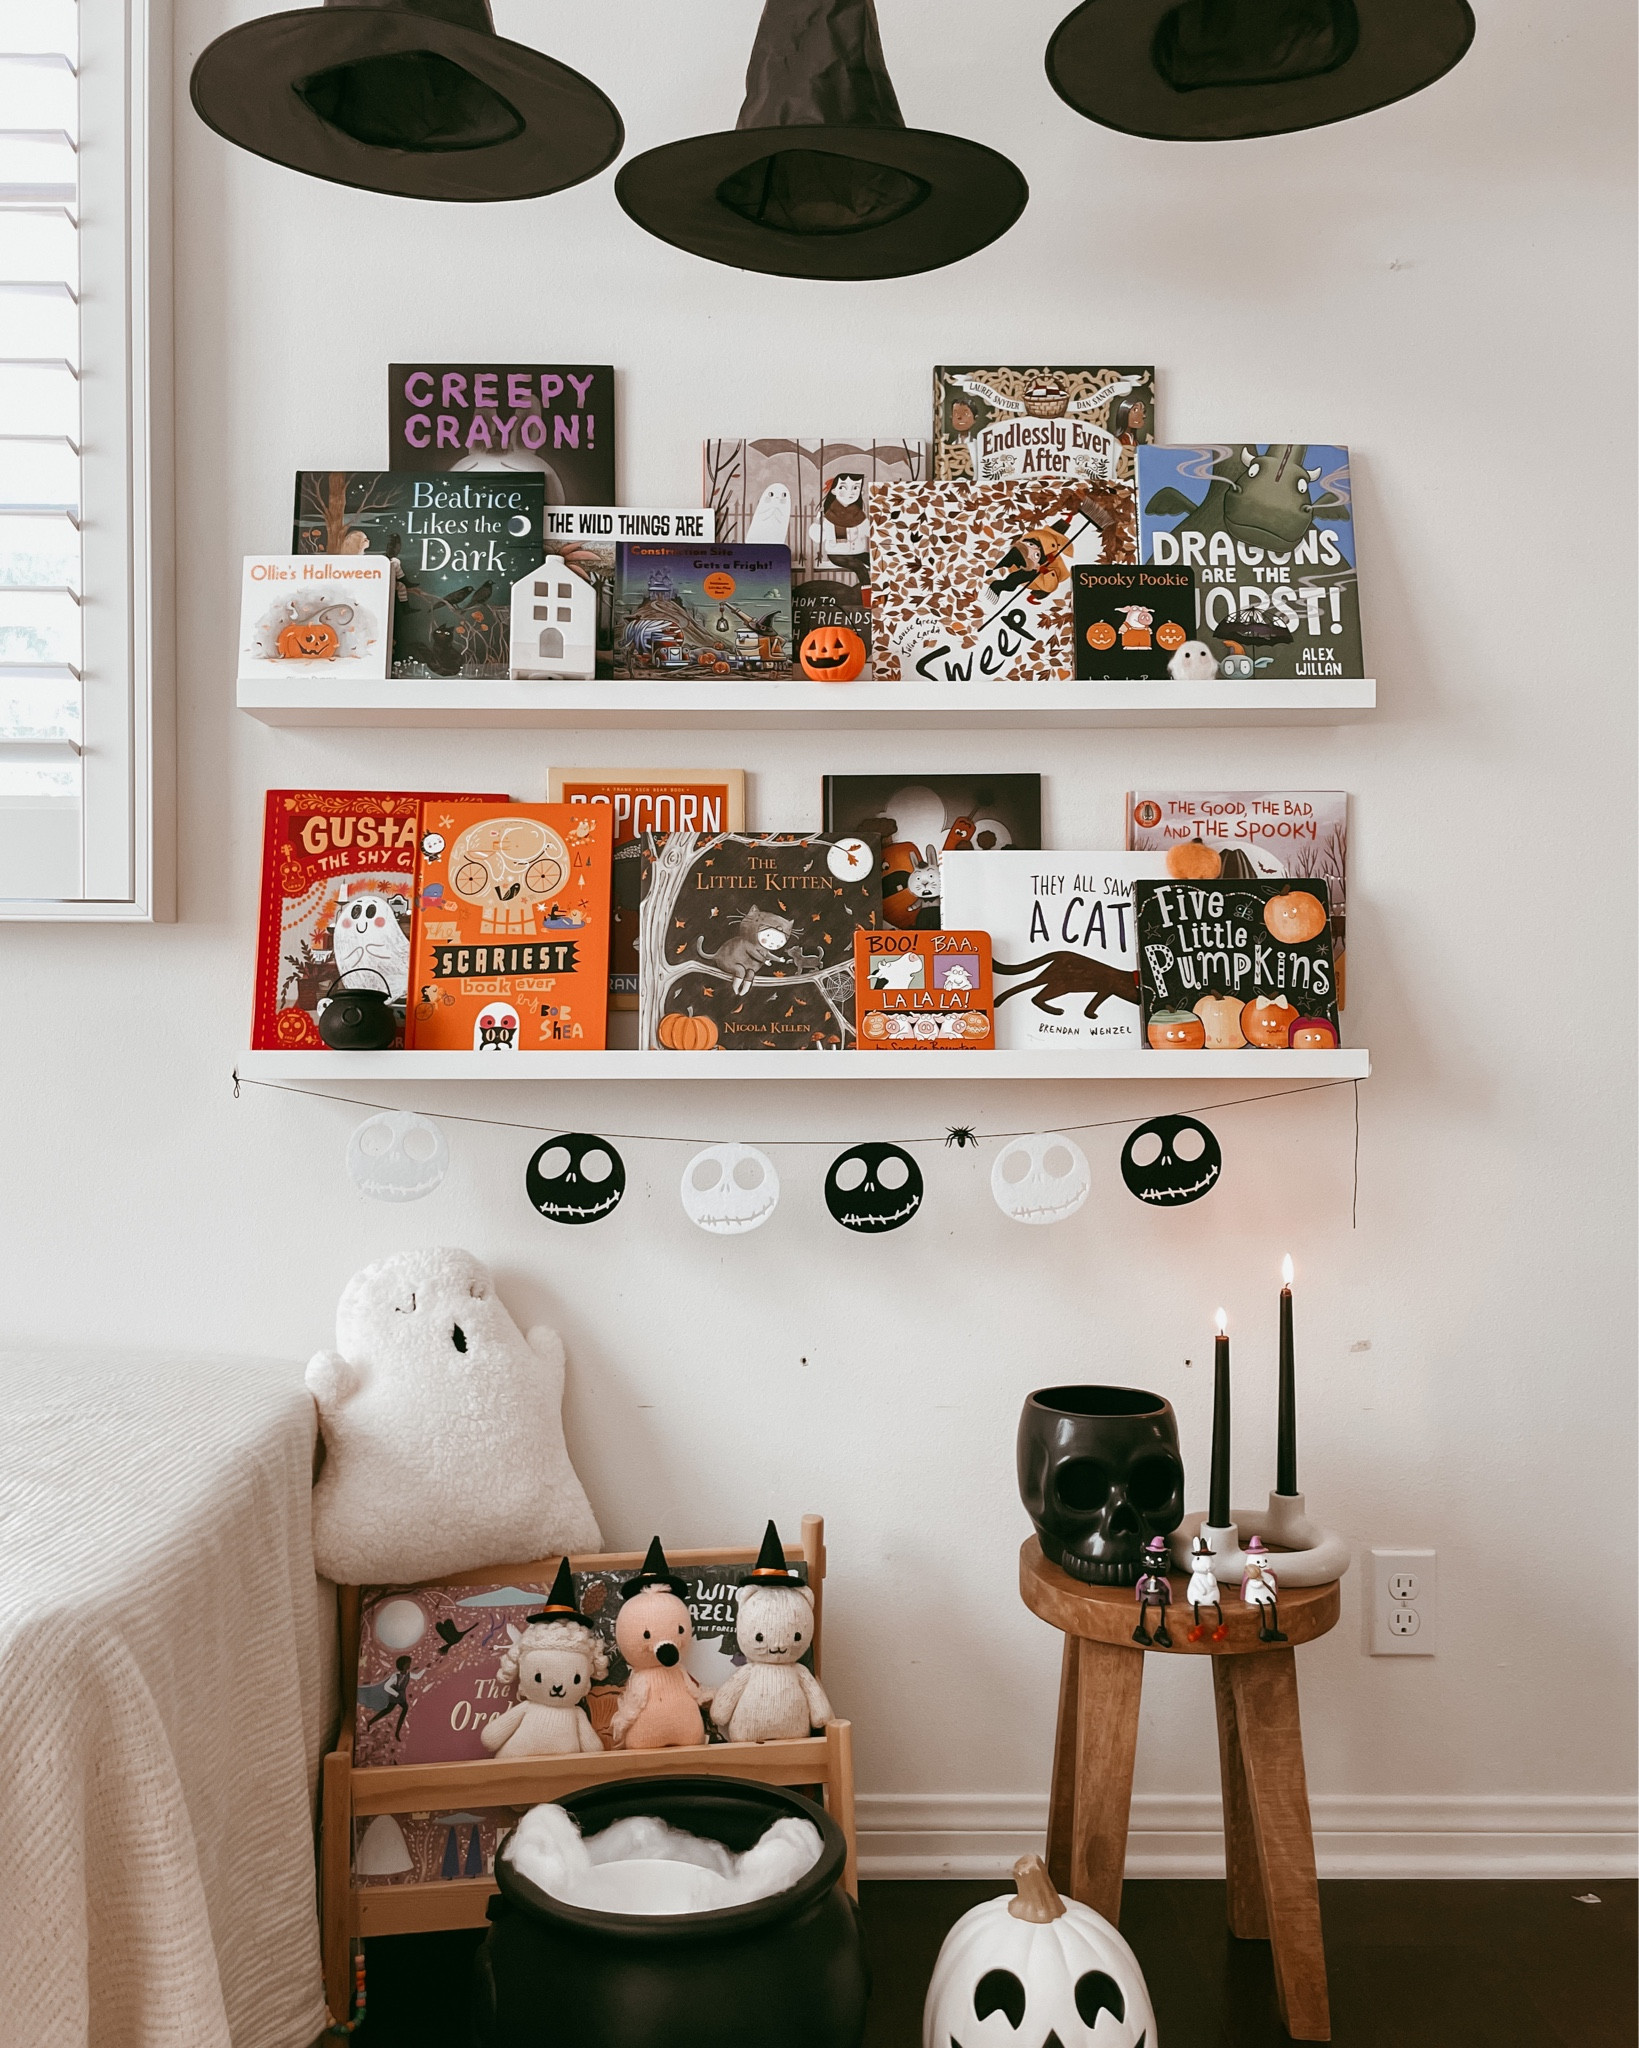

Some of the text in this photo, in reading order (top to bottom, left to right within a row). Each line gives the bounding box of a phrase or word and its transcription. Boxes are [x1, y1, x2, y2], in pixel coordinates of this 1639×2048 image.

[404, 371, 594, 409] CREEPY
[969, 382, 1020, 410] LAUREL SNYDER
[1076, 385, 1116, 410] DAN SANTAT
[404, 413, 594, 450] CRAYON!
[982, 421, 1111, 457] Endlessly Ever
[1022, 449, 1070, 473] After
[412, 482, 522, 510] Beatrice
[407, 511, 502, 535] Likes the
[547, 513, 704, 536] THE WILD THINGS ARE
[419, 537, 507, 572] Dark
[710, 546, 734, 556] Site
[251, 564, 382, 580] Ollie's Halloween
[693, 560, 720, 569] Gets
[733, 560, 773, 572] Fright!
[1202, 567, 1290, 583] ARE THE
[1080, 572, 1189, 588] Spooky Pookie
[792, 596, 817, 607] HOW
[1195, 586, 1343, 636] ORST!
[1302, 648, 1335, 661] ALEX
[1295, 662, 1342, 676] WILLAN
[571, 794, 721, 839] PCORN
[1168, 800, 1314, 819] THE GOOD, THE BAD,
[1164, 819, 1317, 843] AND THE SPOOKY
[318, 852, 350, 871] THE
[357, 850, 392, 865] SHY
[748, 856, 777, 870] THE
[696, 872, 833, 891] LITTLE KITTEN
[1030, 873, 1134, 897] THEY ALL SAW
[1153, 885, 1225, 928] Five
[1030, 897, 1131, 953] A CAT
[865, 934, 979, 953] BOO! BAA,
[1177, 920, 1248, 953] Little
[442, 946, 568, 975] SCARIEST
[463, 977, 553, 993] book ever
[883, 991, 970, 1009] LA LA LA!
[724, 1022, 811, 1033] NICOLA KILLEN
[1038, 1023, 1132, 1036] BRENDAN WENZEL
[474, 1678, 511, 1699] The
